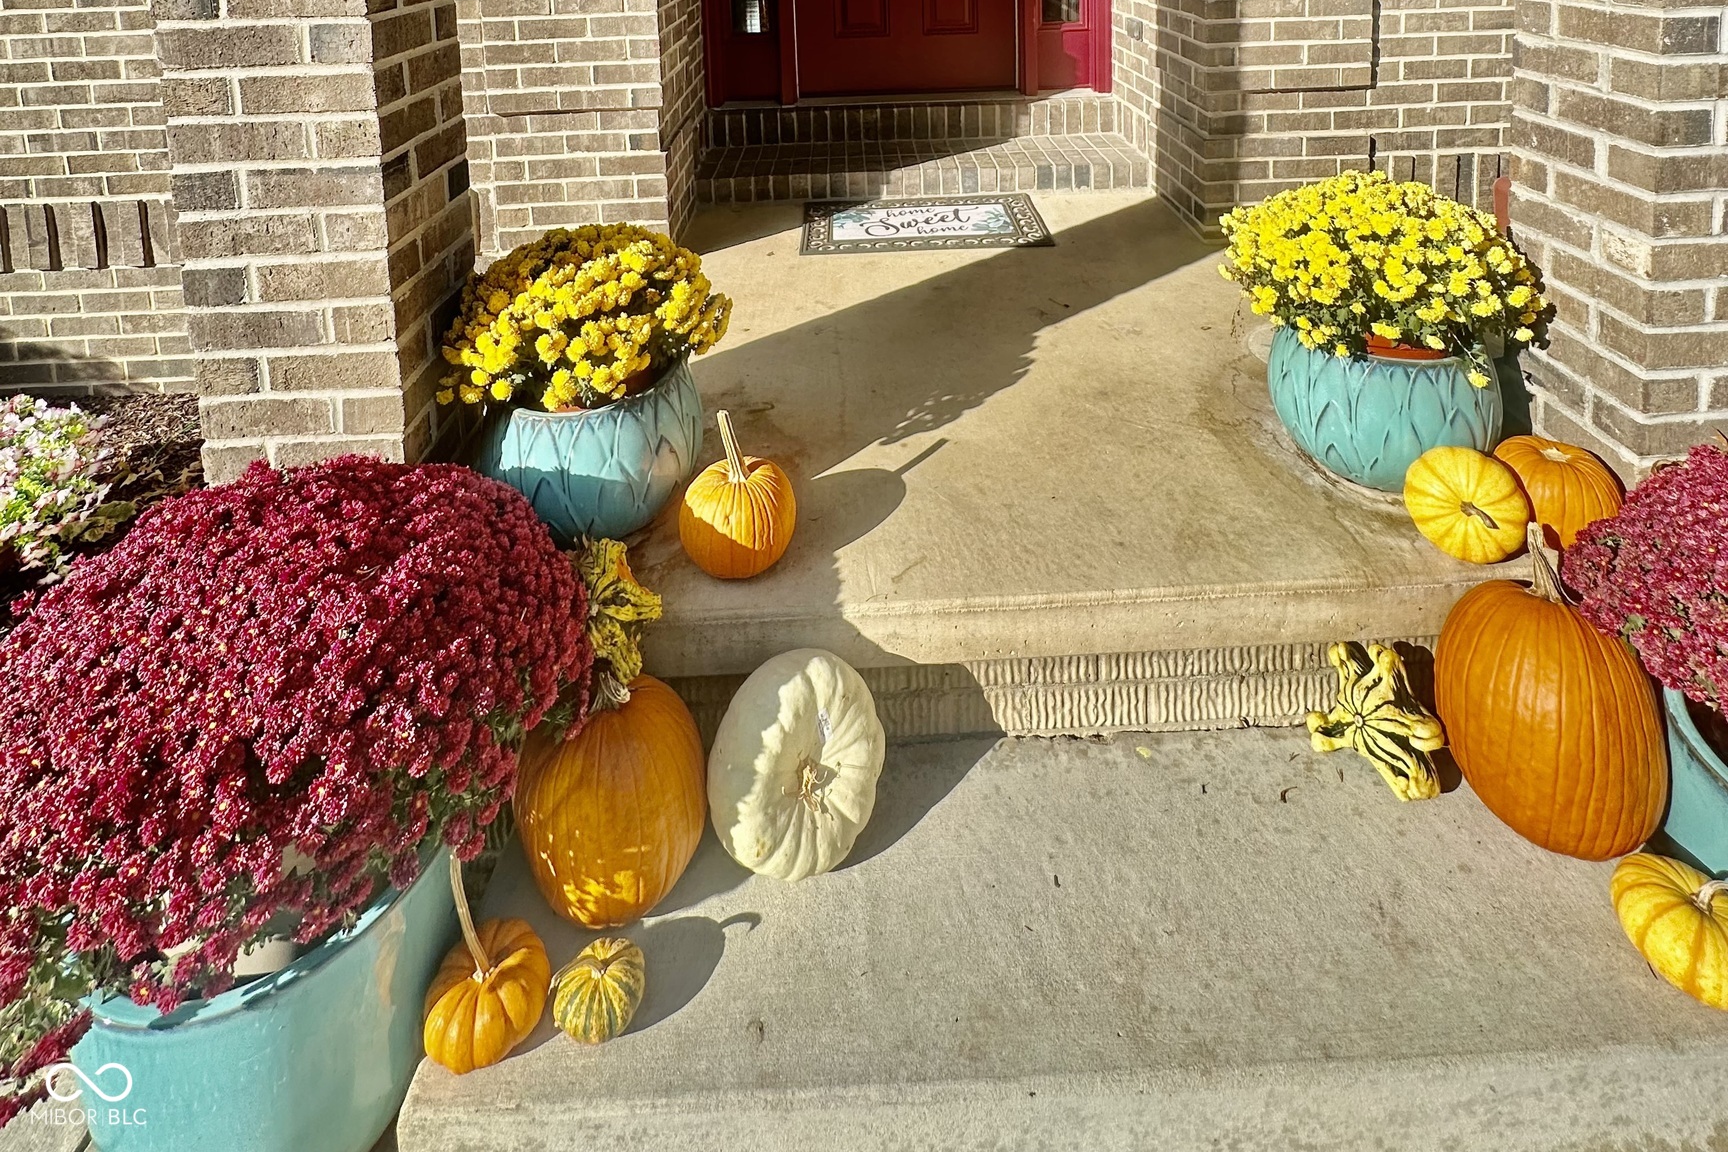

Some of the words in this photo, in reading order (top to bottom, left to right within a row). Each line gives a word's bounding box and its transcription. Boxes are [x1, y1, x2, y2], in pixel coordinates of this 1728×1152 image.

[886, 207, 936, 218] home
[859, 207, 978, 236] Sweet
[916, 224, 969, 234] home
